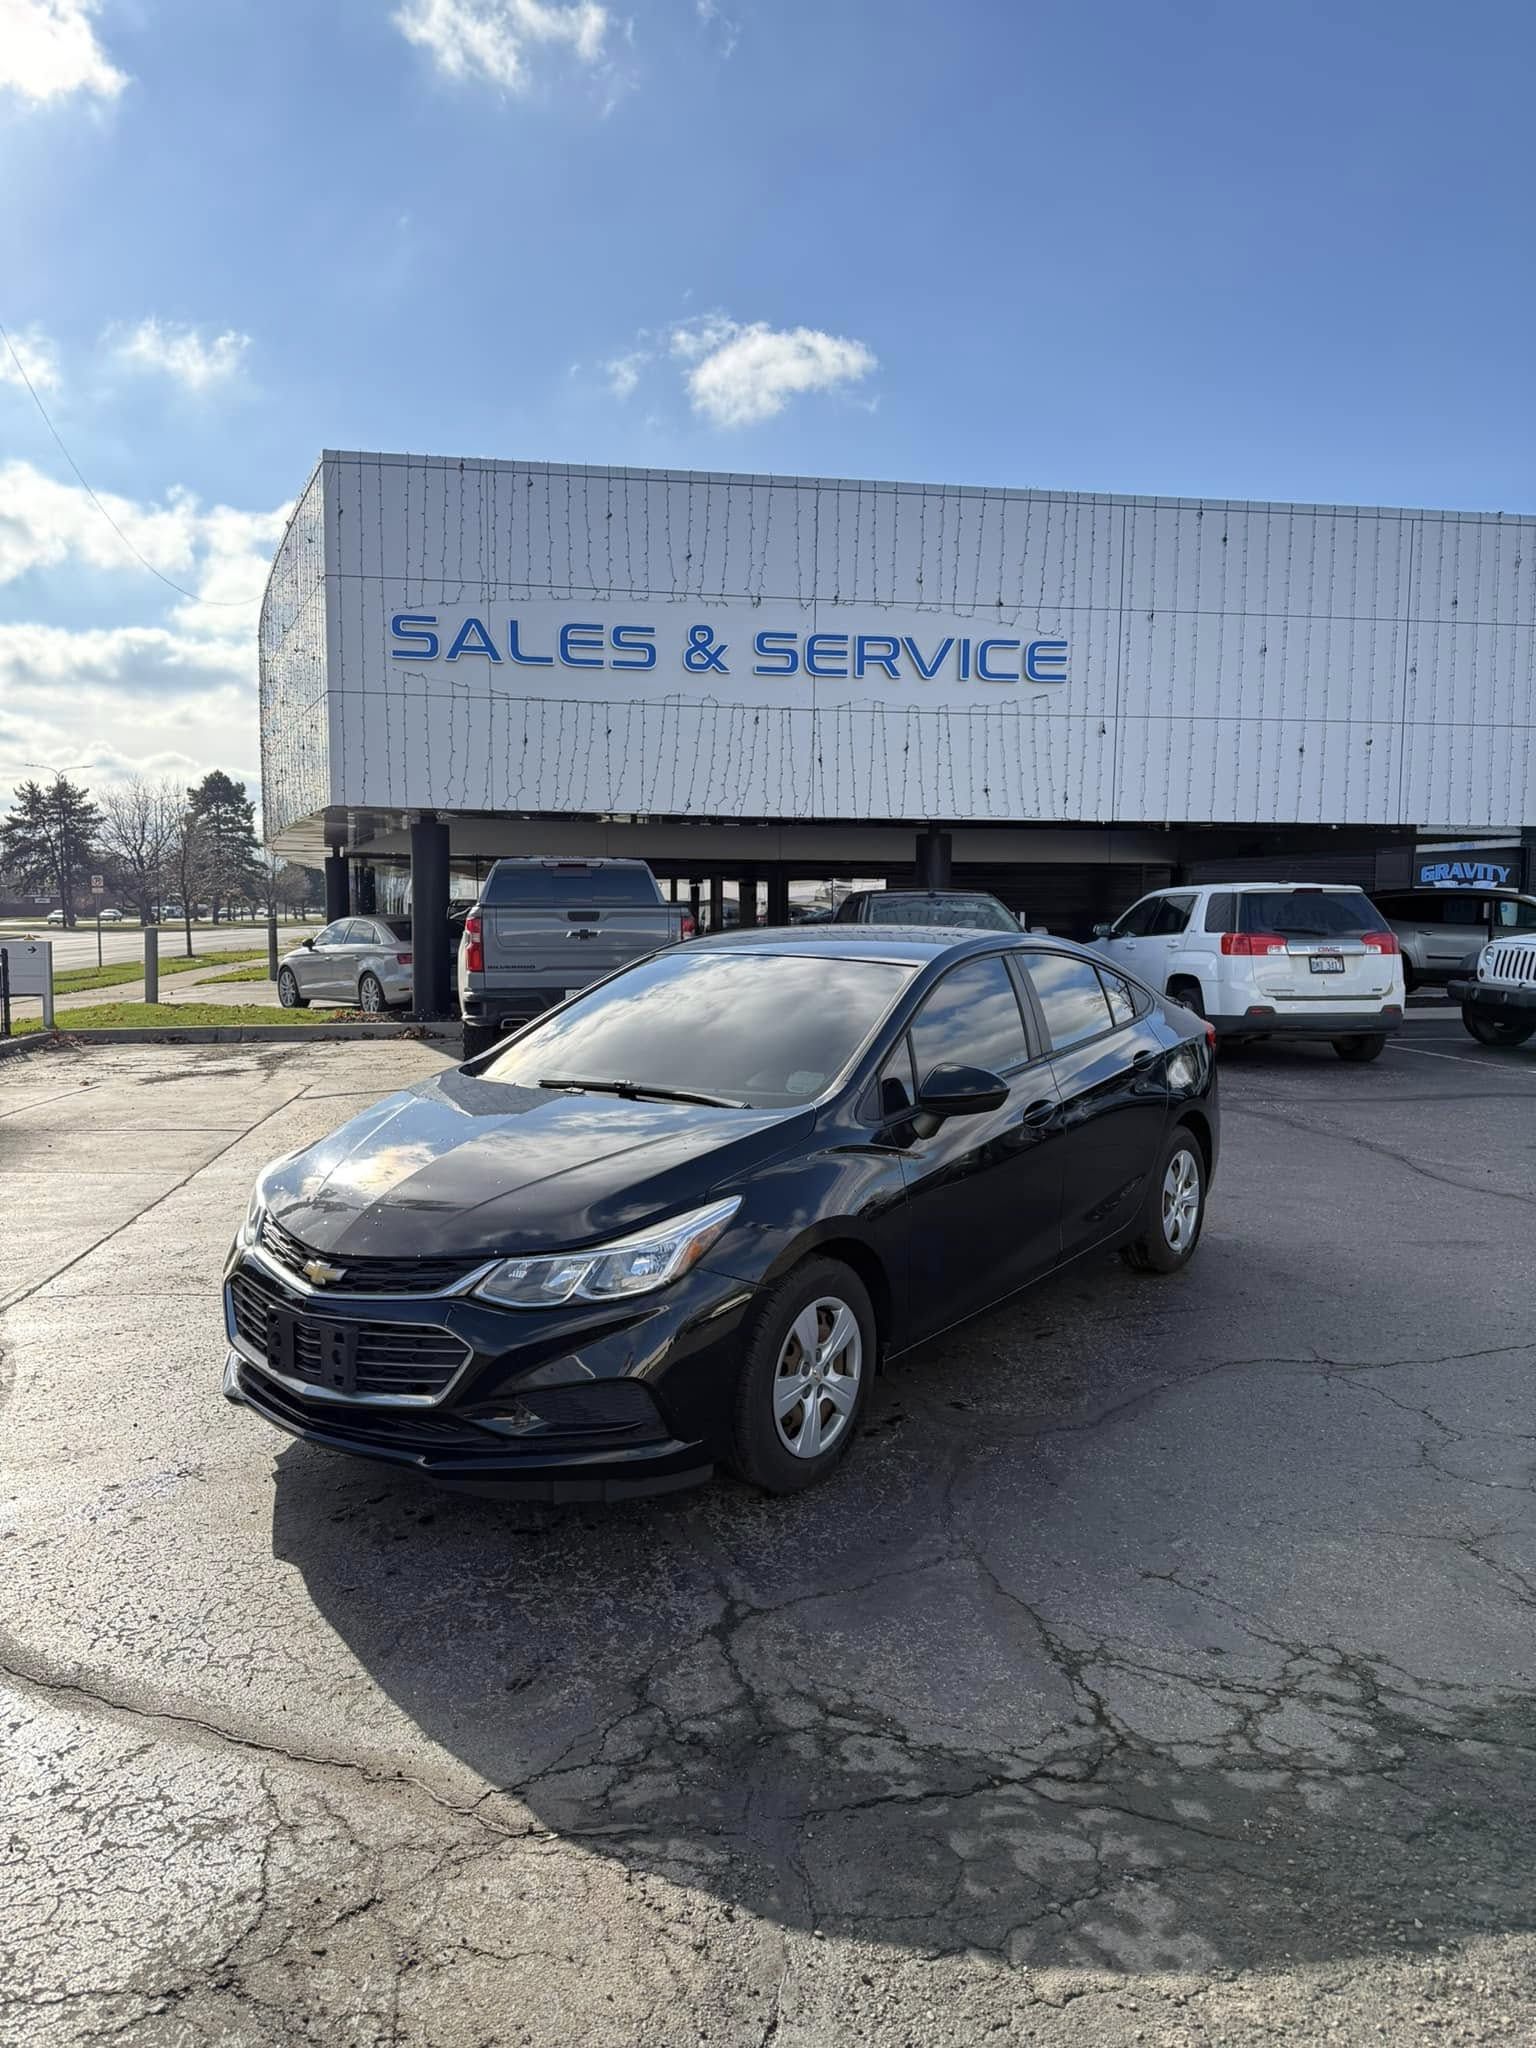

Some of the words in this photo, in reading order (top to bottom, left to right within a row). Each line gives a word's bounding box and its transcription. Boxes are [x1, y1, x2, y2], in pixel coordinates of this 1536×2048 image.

[391, 614, 657, 671] SALES
[683, 624, 731, 674] &
[753, 631, 1069, 683] SERVICE
[1420, 862, 1511, 883] GRAVITY
